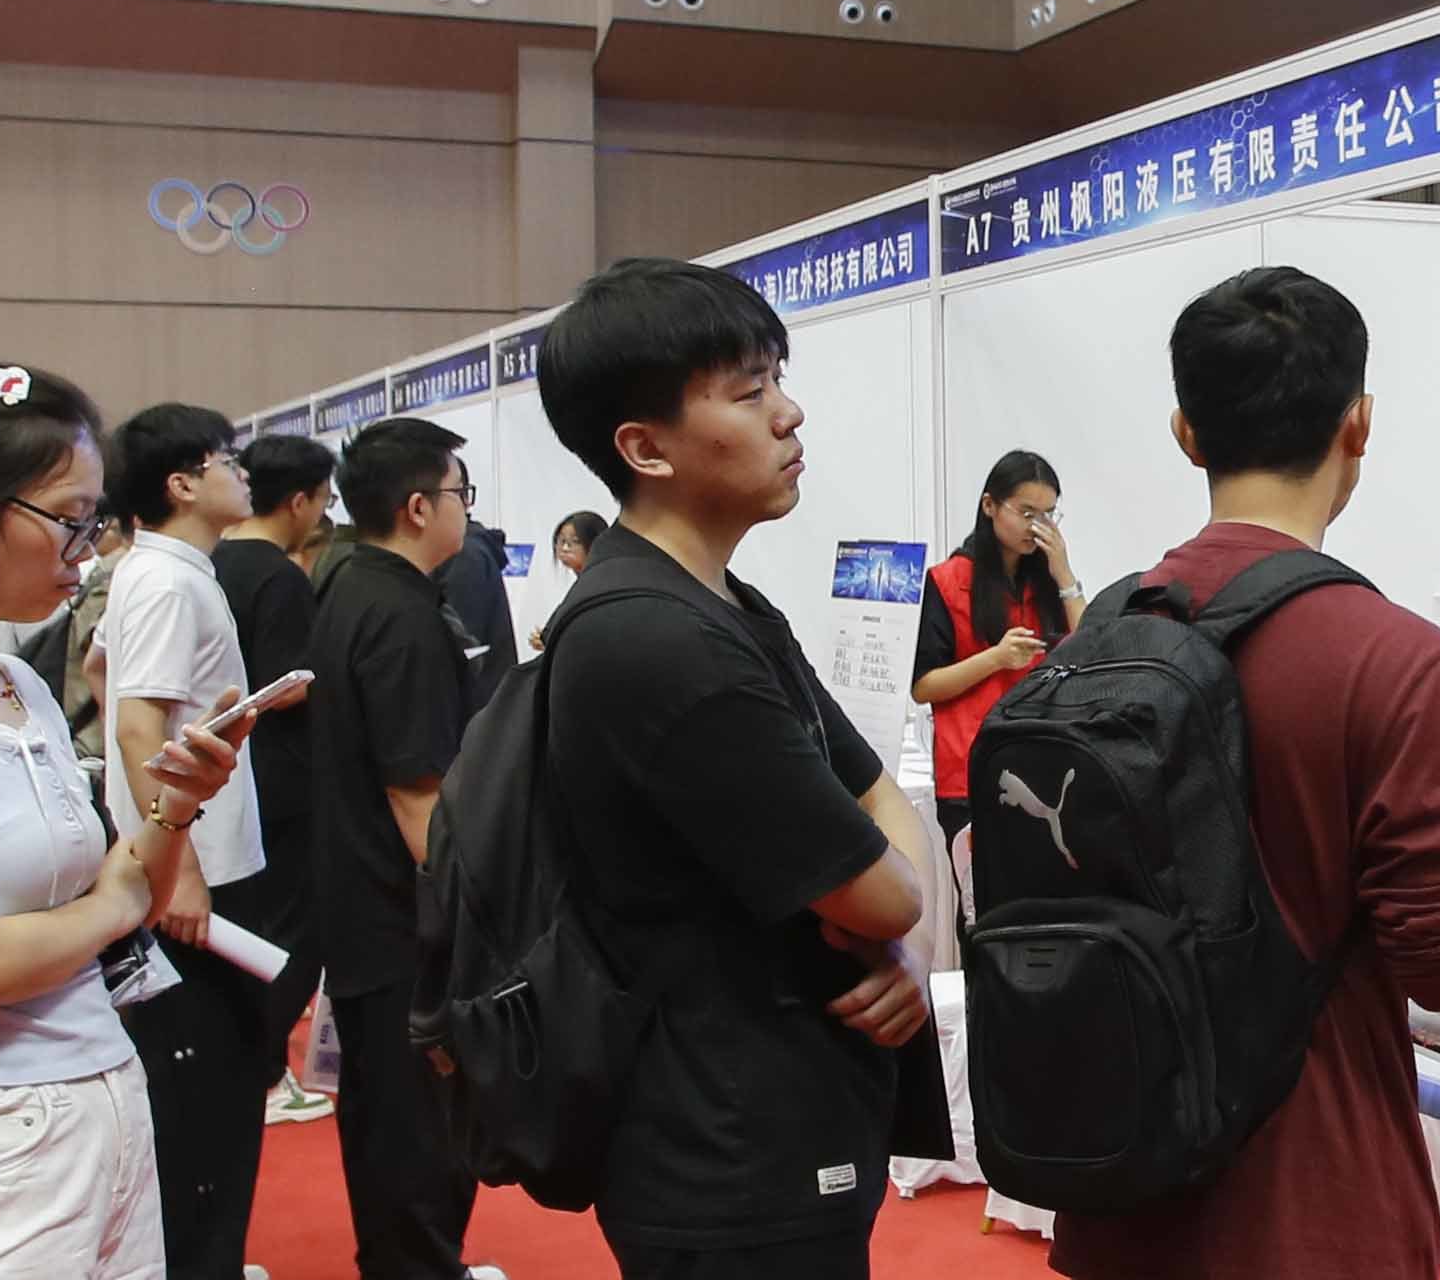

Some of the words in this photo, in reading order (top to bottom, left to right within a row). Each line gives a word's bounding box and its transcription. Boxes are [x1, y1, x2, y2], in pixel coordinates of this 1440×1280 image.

[966, 211, 992, 256] A7
[746, 231, 914, 306] 上海)红外科技有限公司
